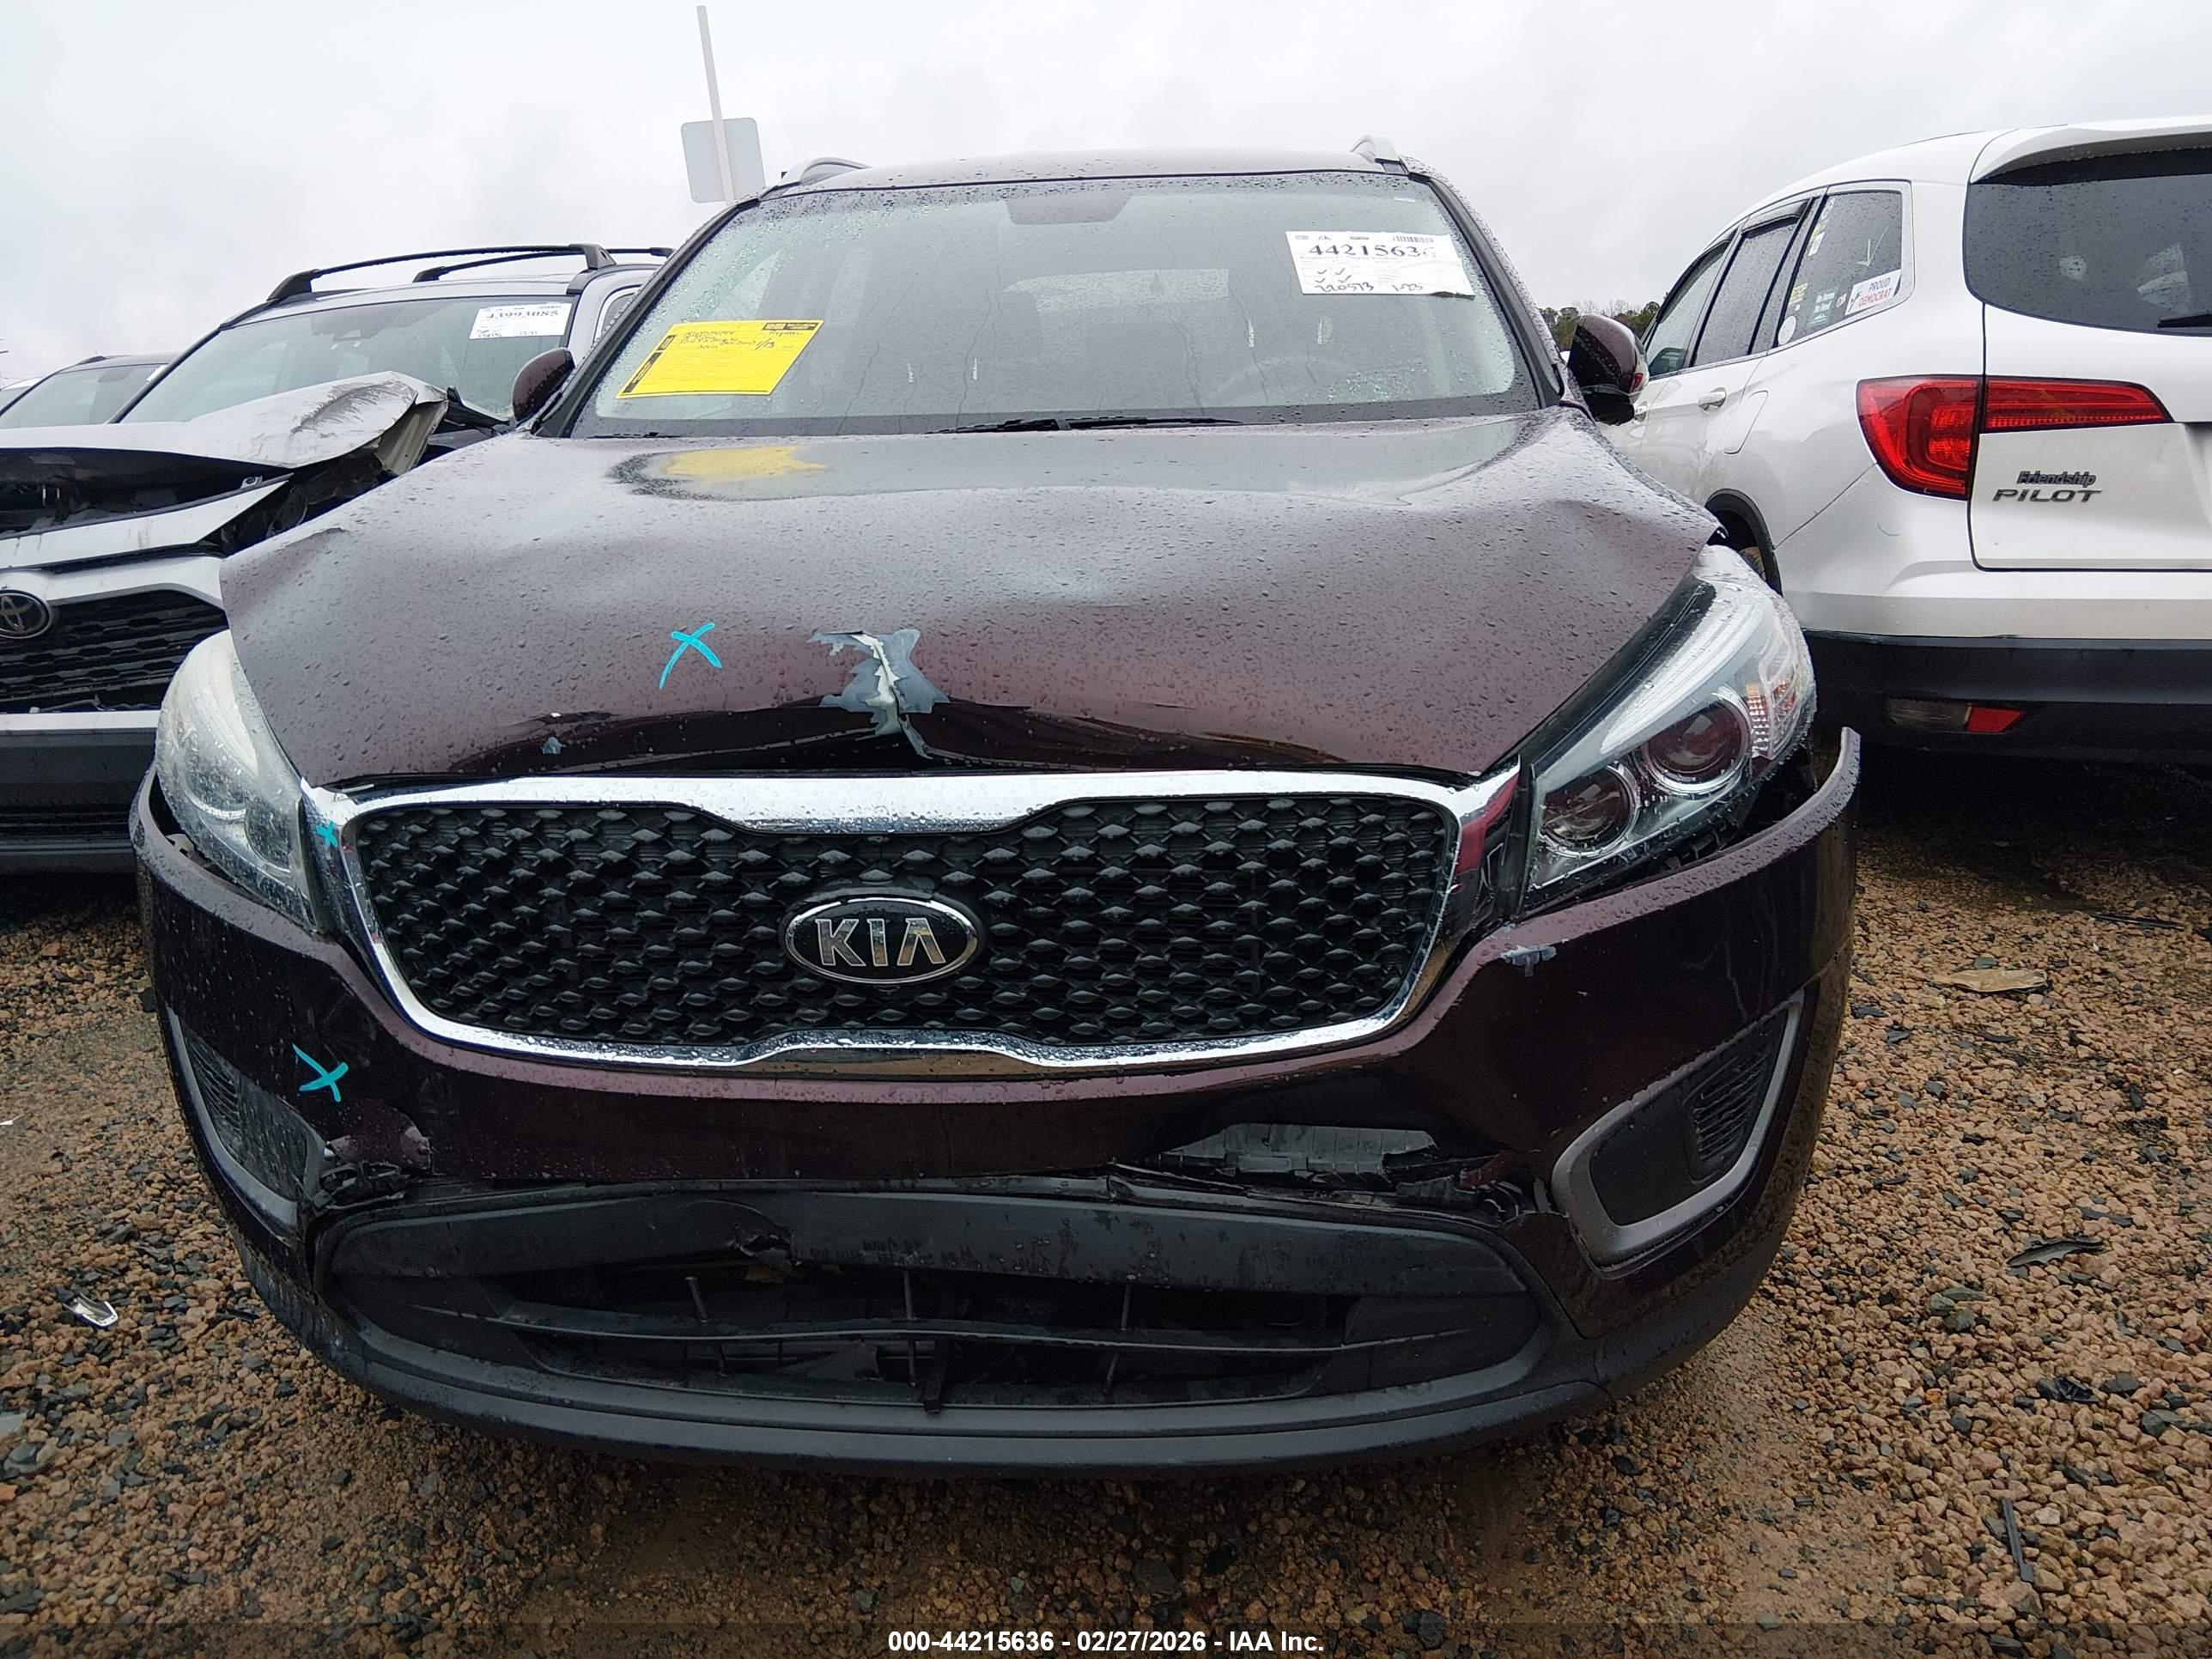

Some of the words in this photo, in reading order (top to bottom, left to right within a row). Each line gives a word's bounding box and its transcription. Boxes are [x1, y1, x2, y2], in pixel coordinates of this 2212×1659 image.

[1868, 277, 1891, 292] PROUD
[1858, 288, 1893, 307] DEMOCRAT
[2016, 471, 2097, 488] Friendship
[1992, 489, 2103, 502] PILOT
[815, 917, 946, 967] KIA
